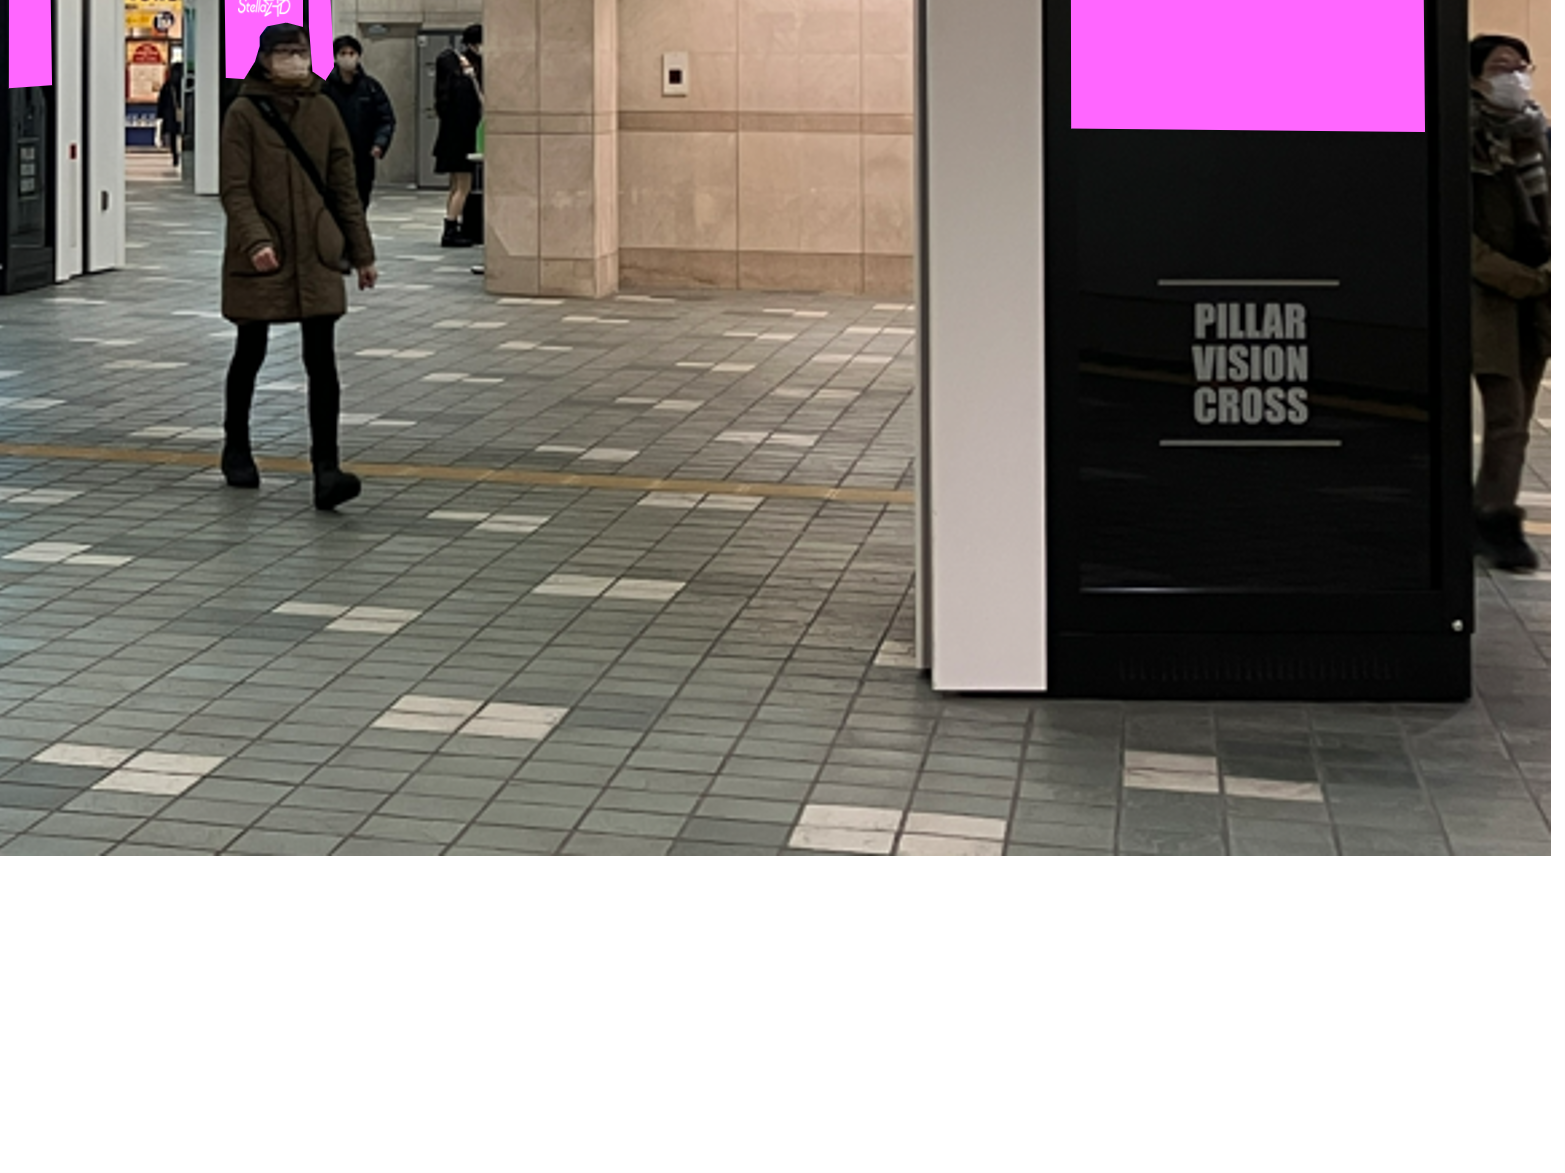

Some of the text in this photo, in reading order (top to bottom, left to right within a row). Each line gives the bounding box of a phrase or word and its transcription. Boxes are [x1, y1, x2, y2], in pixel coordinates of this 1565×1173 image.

[1191, 302, 1309, 339] PILLAR
[1191, 344, 1309, 382] VISION
[1191, 386, 1309, 424] CROSS
